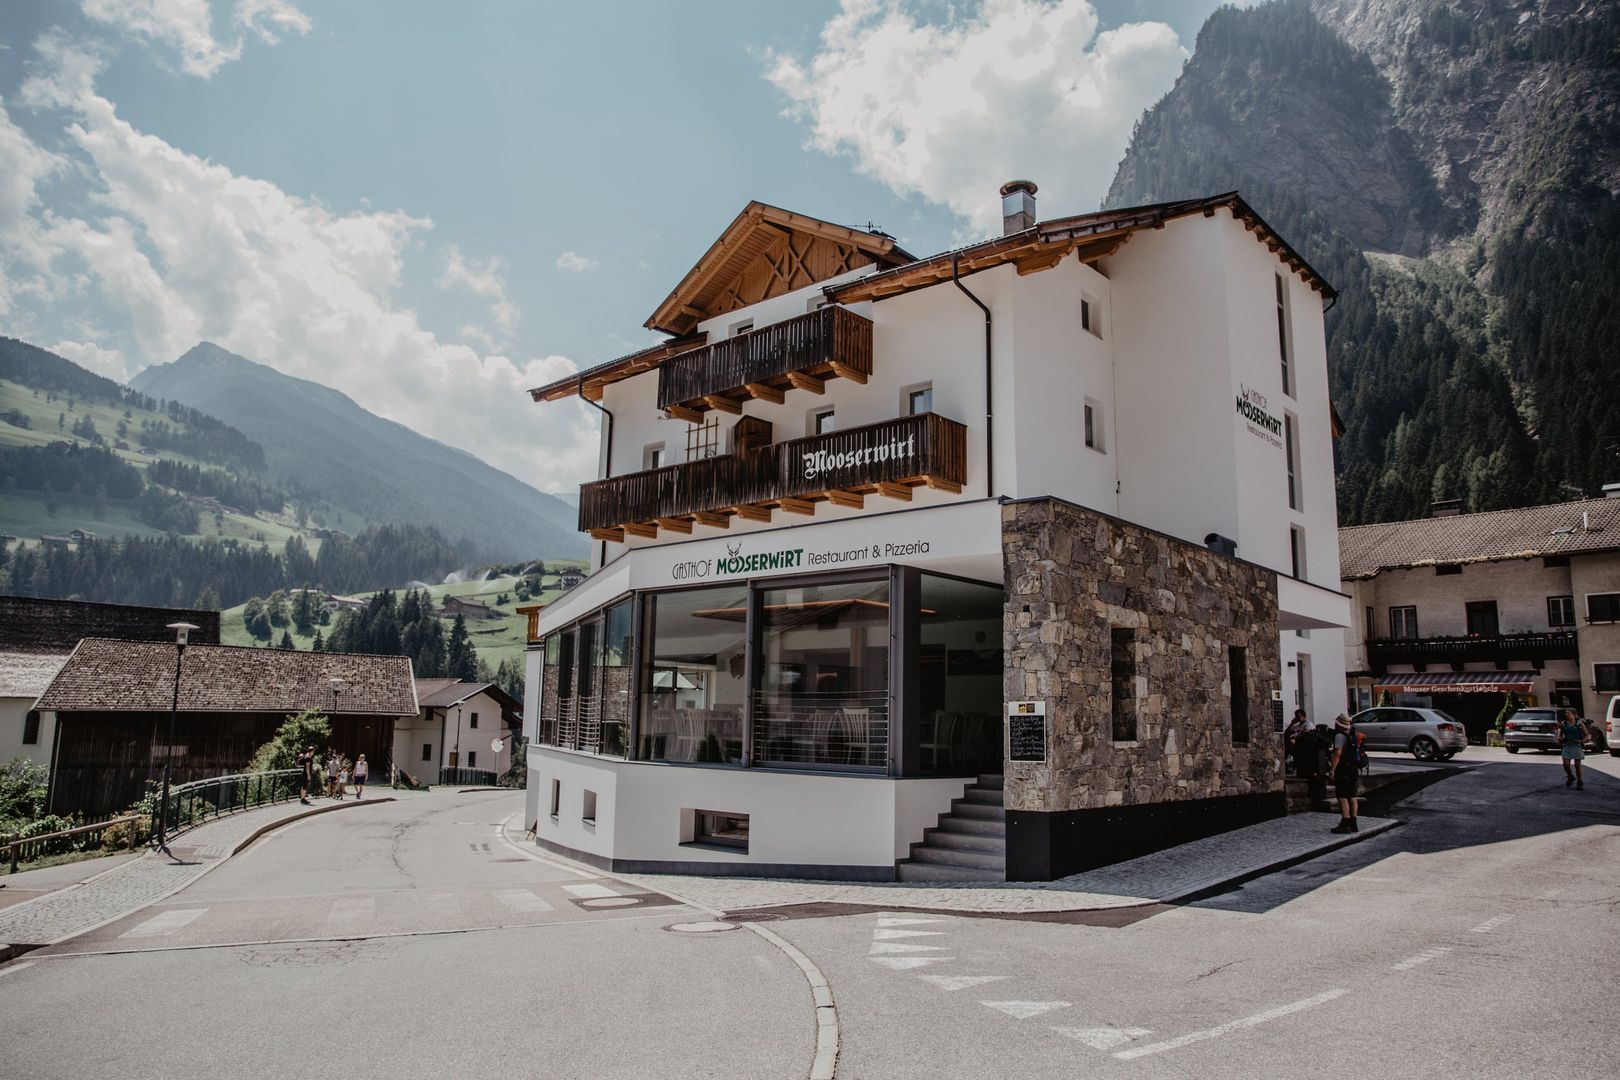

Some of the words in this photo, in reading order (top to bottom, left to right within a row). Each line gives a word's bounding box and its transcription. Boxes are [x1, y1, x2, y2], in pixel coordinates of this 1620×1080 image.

[802, 433, 915, 479] Mooserwirt
[808, 547, 869, 565] Restaurant
[872, 544, 881, 559] &
[885, 540, 930, 557] Pizzeria
